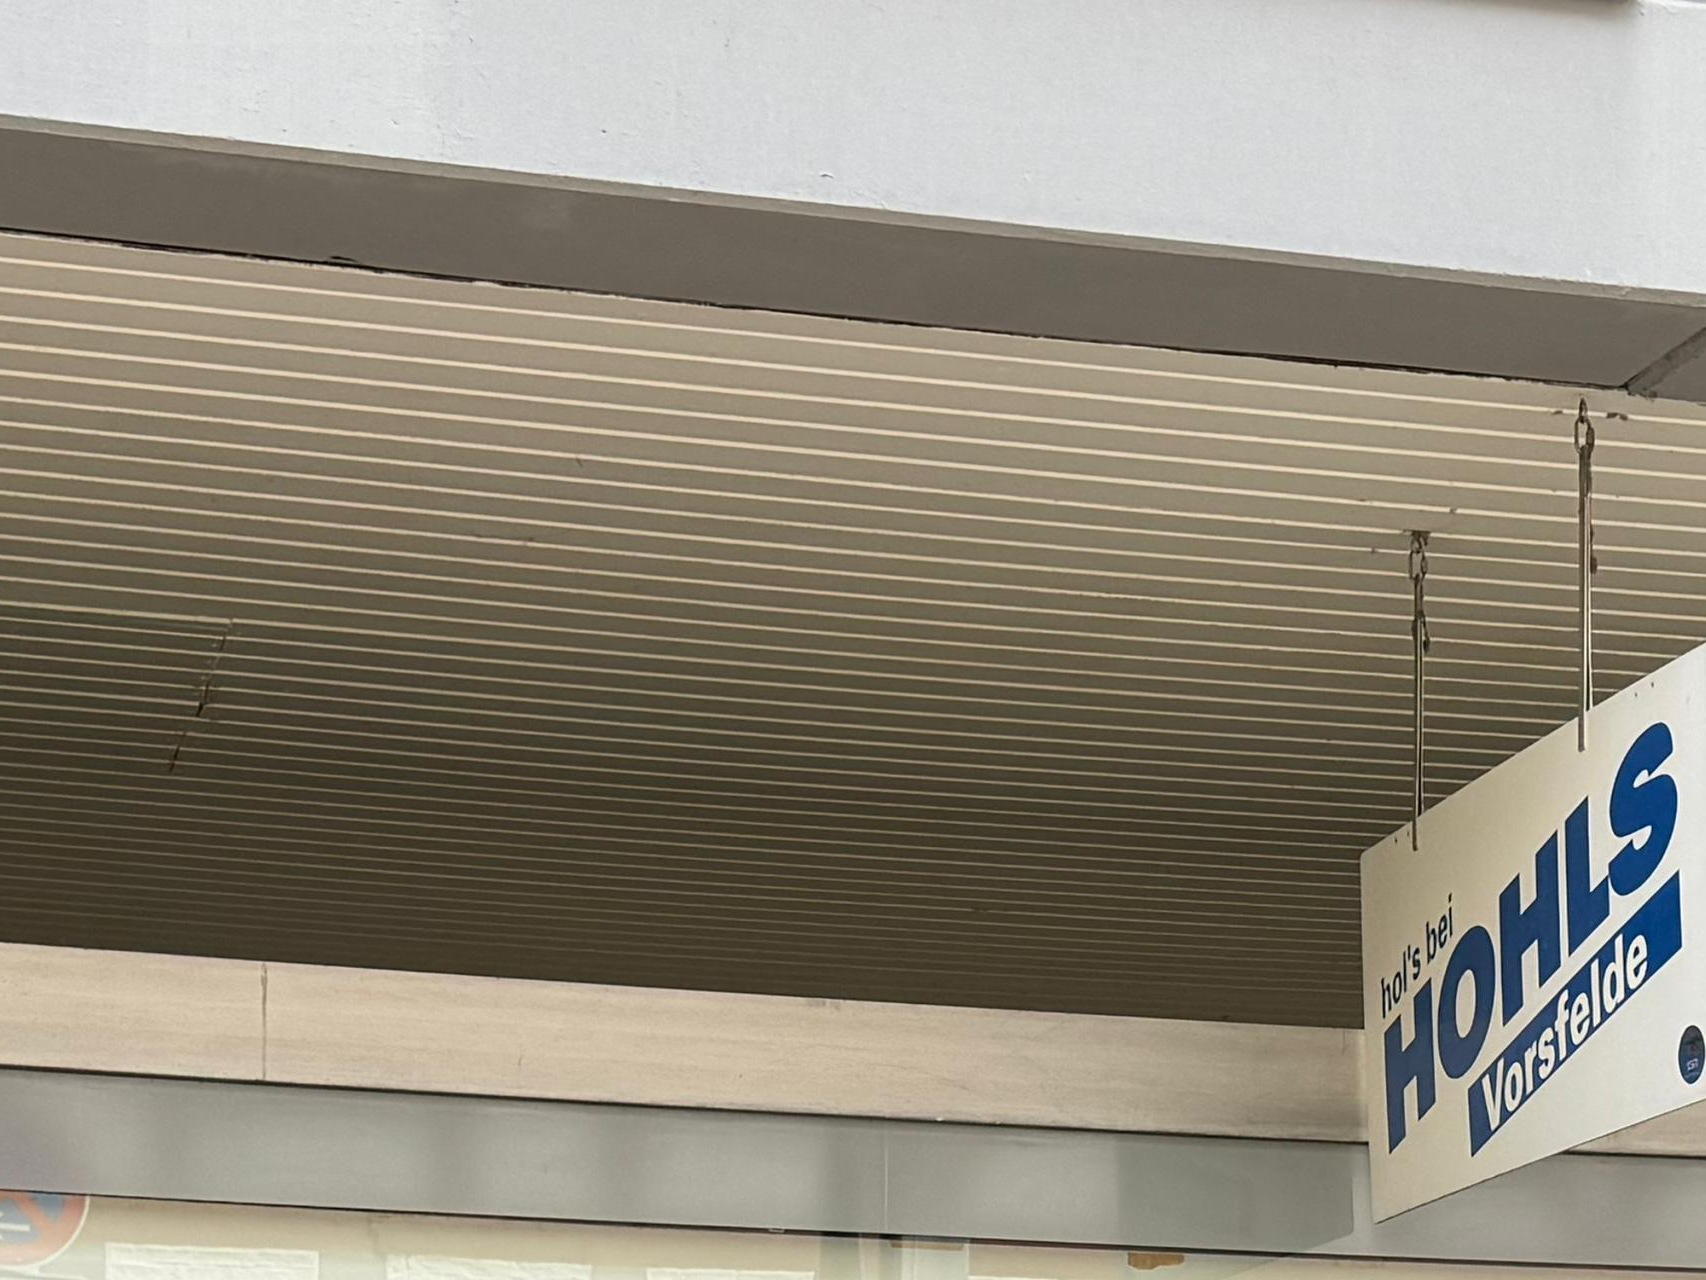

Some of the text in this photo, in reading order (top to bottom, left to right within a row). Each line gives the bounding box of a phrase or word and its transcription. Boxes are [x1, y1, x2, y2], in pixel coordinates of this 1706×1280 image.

[1381, 892, 1454, 1013] hol's bei
[1382, 720, 1679, 1156] HOHLS
[1481, 930, 1650, 1130] Vorsfelde
